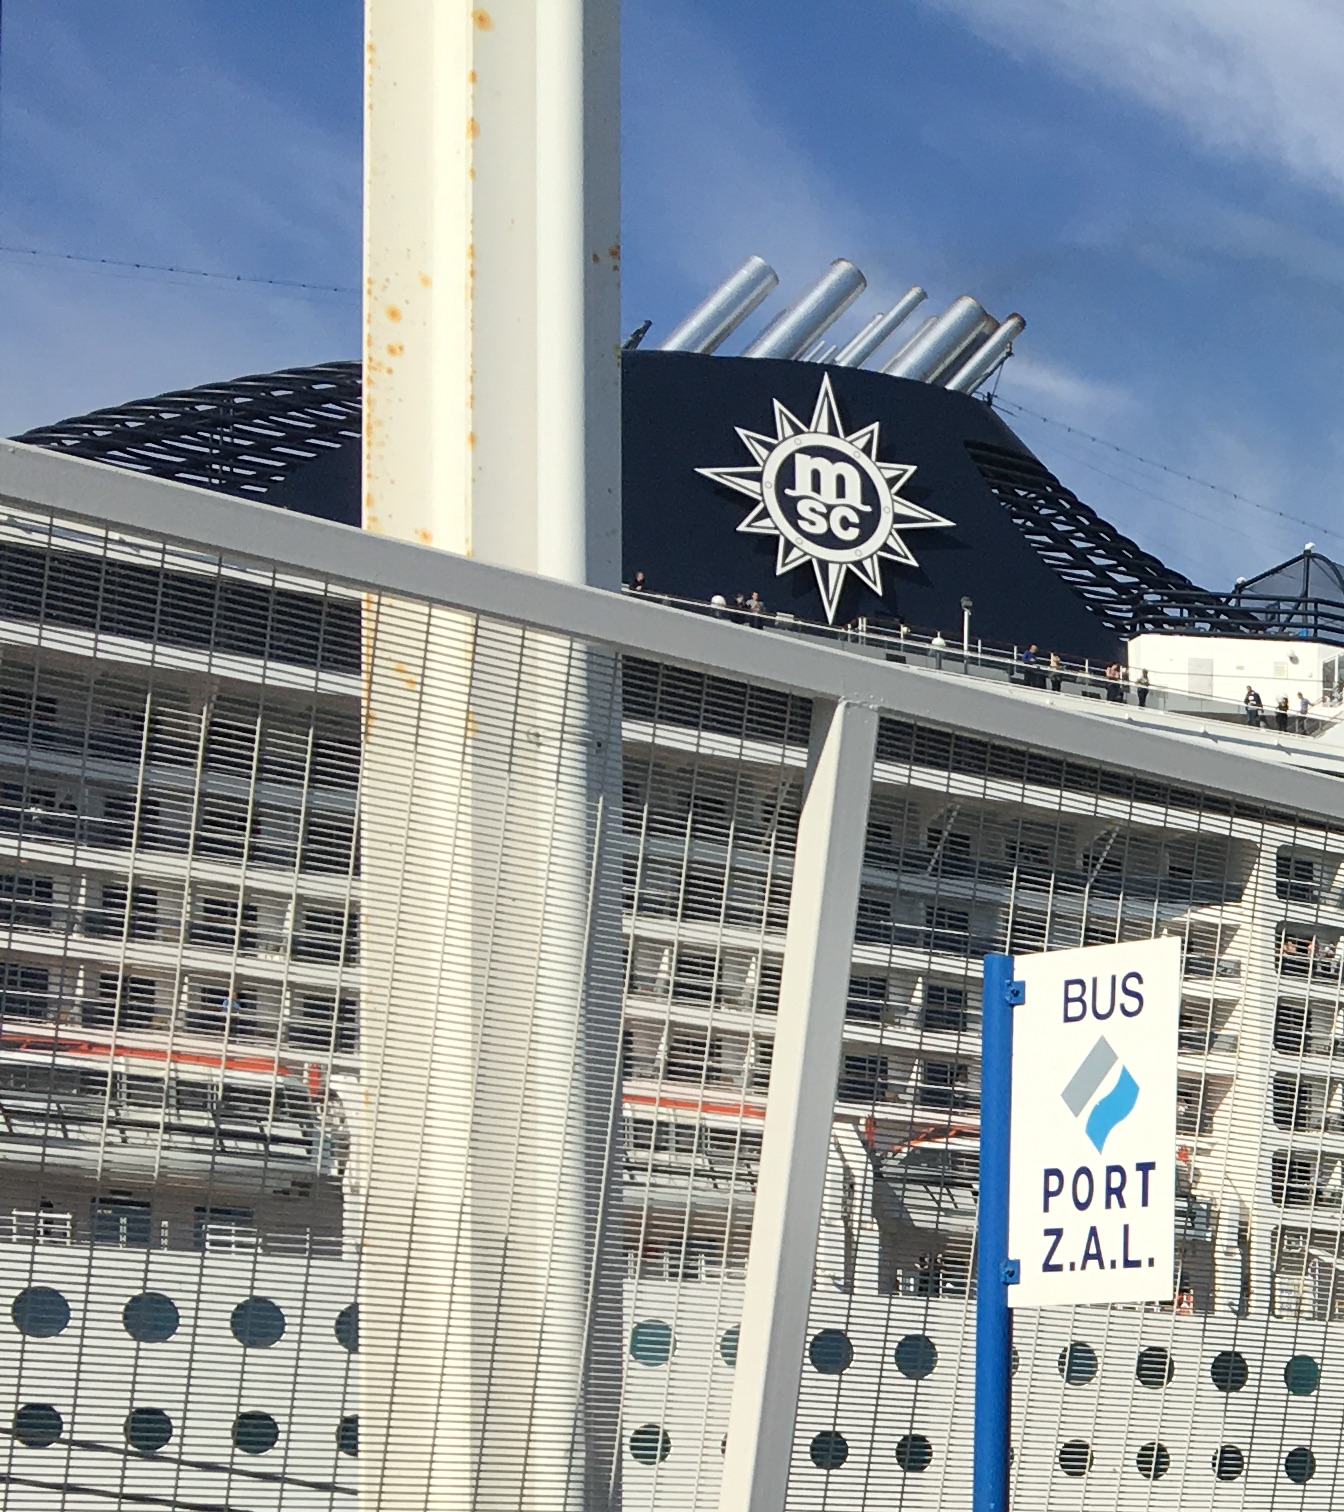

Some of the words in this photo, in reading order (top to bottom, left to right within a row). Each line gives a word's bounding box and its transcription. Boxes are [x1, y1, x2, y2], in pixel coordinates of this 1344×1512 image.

[1062, 970, 1145, 1023] BUS
[1042, 1160, 1157, 1213] PORT
[1041, 1223, 1156, 1273] Z.A.L.
